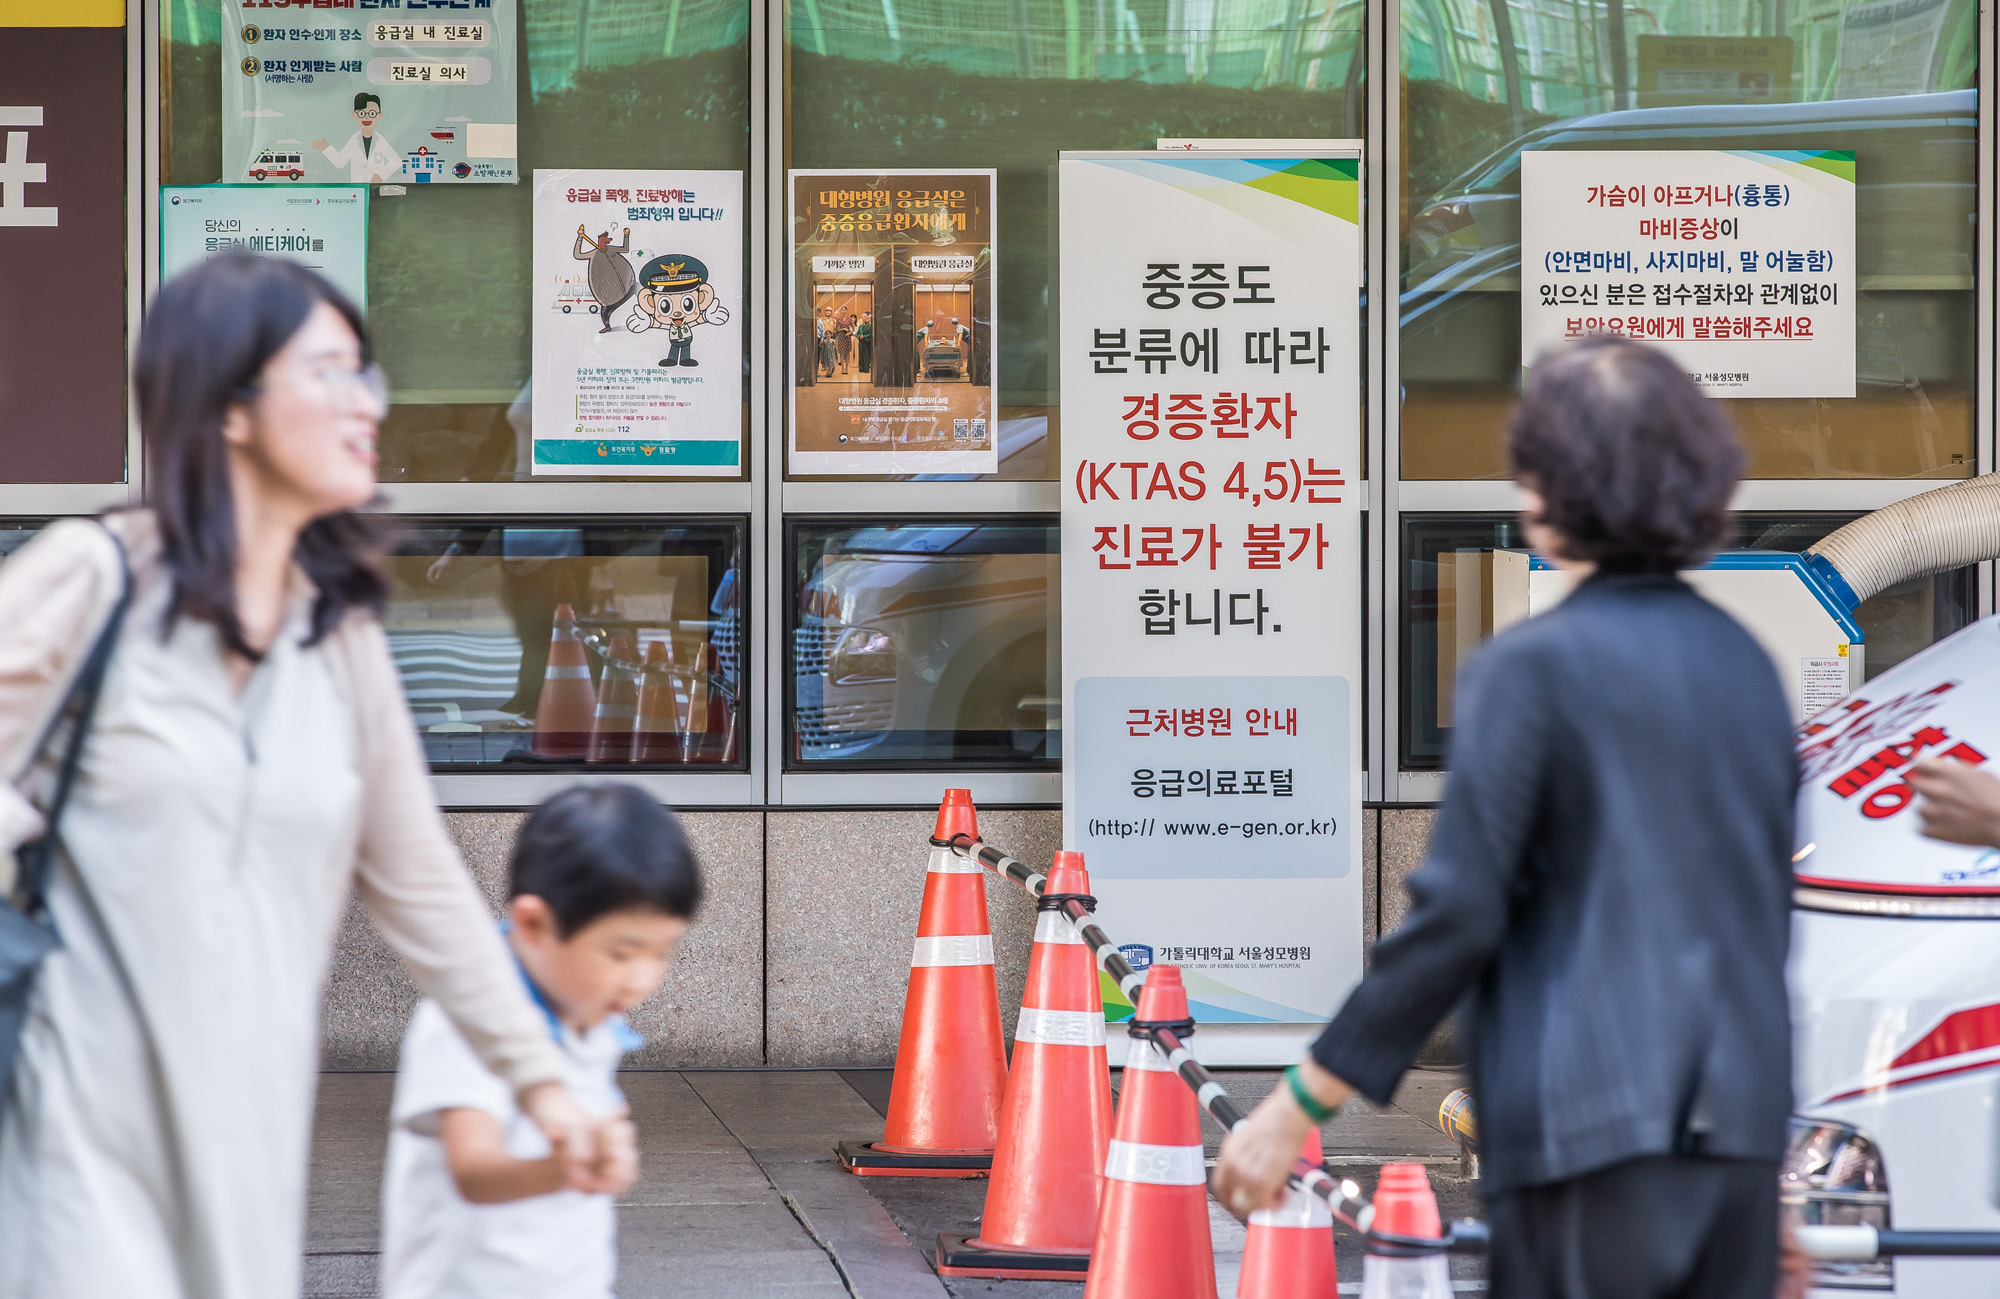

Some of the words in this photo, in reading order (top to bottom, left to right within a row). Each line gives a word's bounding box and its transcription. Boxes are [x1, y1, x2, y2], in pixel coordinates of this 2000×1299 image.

[263, 29, 286, 41] 환자
[339, 29, 362, 41] 장소
[375, 25, 414, 40] 응급실
[423, 25, 435, 40] 내
[444, 25, 483, 40] 진료실
[263, 60, 287, 73] 환자
[290, 60, 336, 73] 인계받는
[339, 60, 363, 73] 사람
[392, 66, 431, 81] 진료실
[440, 66, 466, 81] 의사
[565, 188, 601, 203] 응급실
[605, 188, 632, 203] 폭행,
[636, 188, 695, 203] 진료방해는
[819, 190, 890, 209] 대형병원
[896, 190, 967, 209] 응급실은
[1587, 184, 1647, 208] 가슴이
[1654, 184, 1790, 208] 아프거나(흉통)
[627, 207, 674, 222] 범죄행위
[678, 207, 724, 222] 입니다!!
[820, 213, 966, 231] 중증응급환자에게
[205, 219, 241, 233] 당신의
[1639, 217, 1738, 240] 마비증상이
[250, 236, 324, 252] 에티케어를
[914, 259, 947, 269] 대형병원
[948, 259, 972, 269] 응급실
[1544, 250, 1639, 274] (안면마비,
[1645, 250, 1732, 274] 사지마비,
[1740, 250, 1760, 274] 말
[1765, 250, 1833, 274] 어눌함)
[1142, 263, 1275, 310] 중증도
[1539, 283, 1599, 306] 있으신
[1605, 283, 1647, 306] 분은
[1652, 283, 1754, 306] 접수절차와
[1759, 283, 1838, 306] 관계없이
[1692, 316, 1814, 339] 말씀해주세요
[1089, 327, 1219, 374] 분류에
[1245, 327, 1330, 374] 따라
[1704, 372, 1749, 382] 서울성모병원
[1121, 392, 1298, 440] 경증환자
[617, 425, 630, 433] 112
[1076, 459, 1206, 504] (KTAS
[1223, 458, 1345, 508] 4,5)는
[1092, 523, 1222, 570] 진료가
[1243, 523, 1329, 570] 불가
[1139, 588, 1281, 635] 합니다.
[1126, 707, 1232, 737] 근처병원
[1245, 707, 1297, 737] 안내
[1130, 768, 1293, 797] 응급의료포털
[1088, 818, 1155, 839] (http://
[1164, 818, 1337, 838] www.e-gen.or.kr)
[1159, 946, 1234, 961] 가톨릭대학교
[1238, 946, 1311, 961] 서울성모병원
